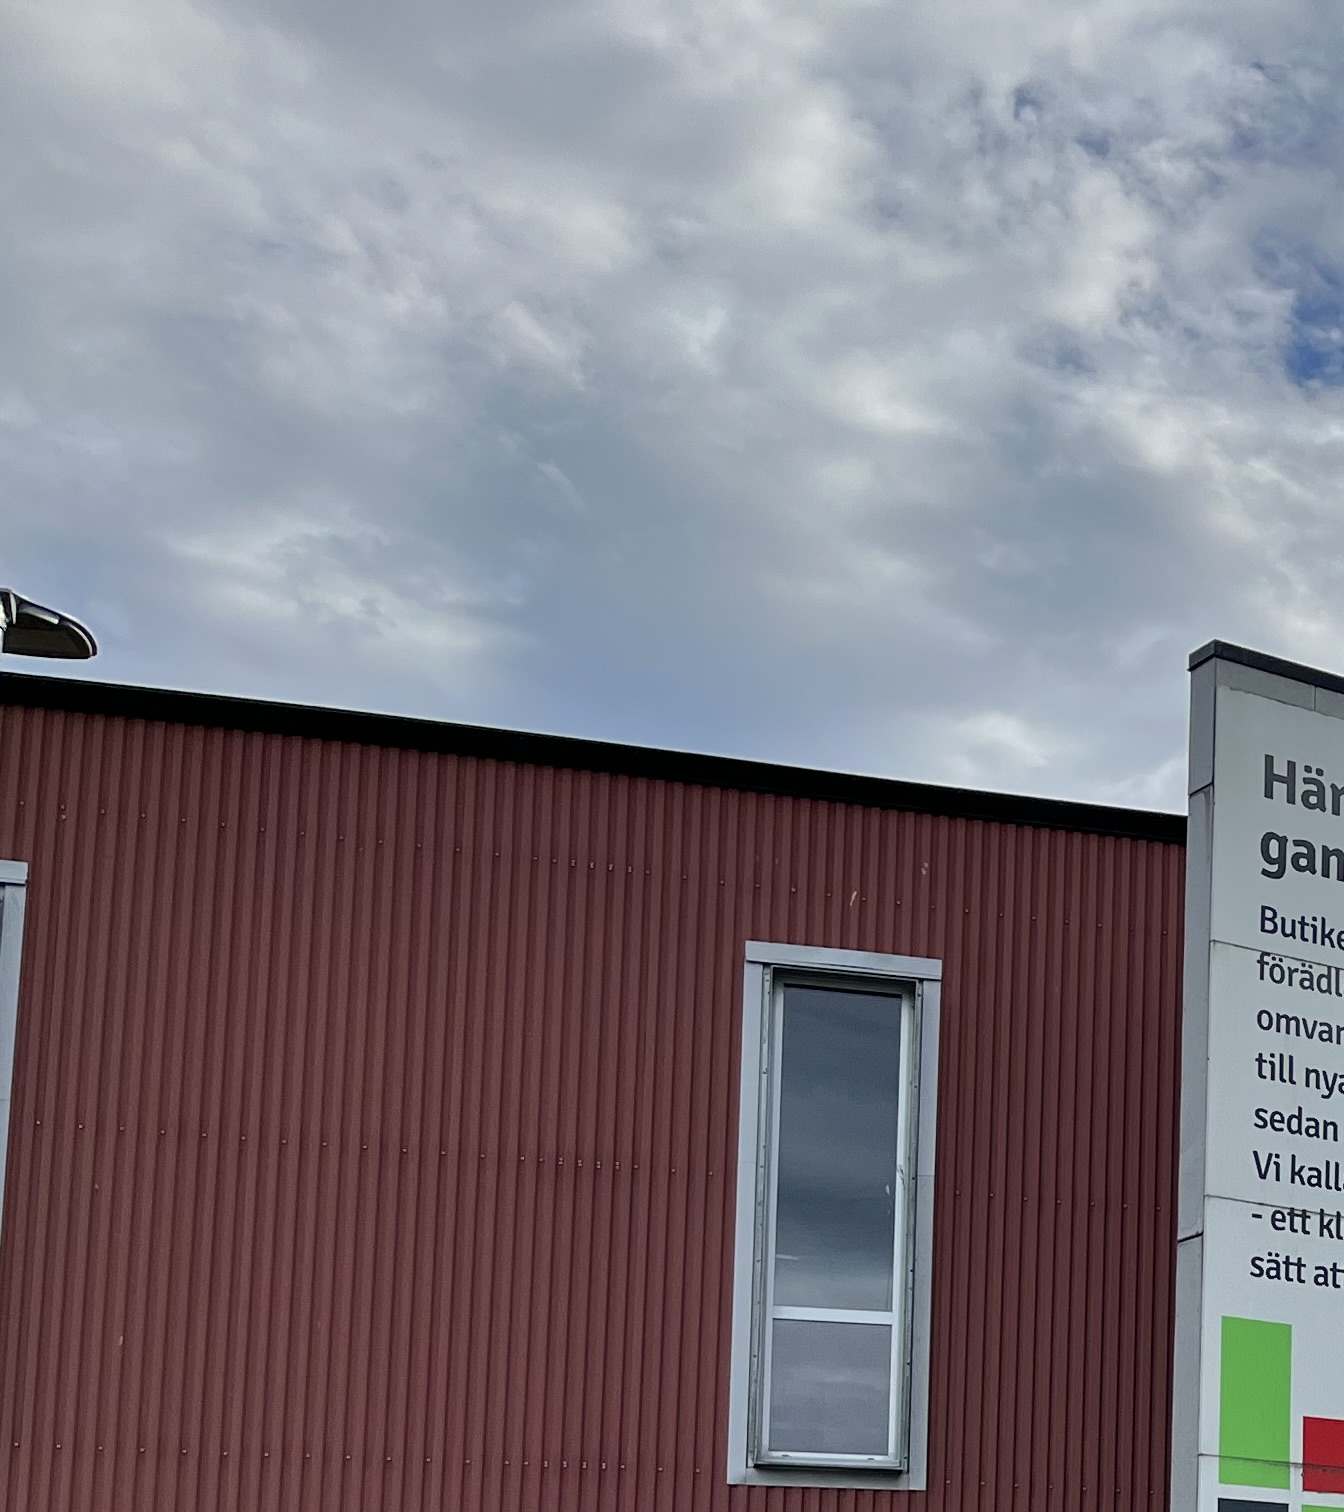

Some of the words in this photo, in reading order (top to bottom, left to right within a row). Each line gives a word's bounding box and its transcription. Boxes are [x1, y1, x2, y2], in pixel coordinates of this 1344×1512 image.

[1256, 1053, 1295, 1085] till
[1254, 1106, 1338, 1142] sedan
[1253, 1150, 1280, 1182] Vi
[1271, 1208, 1310, 1235] ett
[1250, 1252, 1306, 1284] sätt
